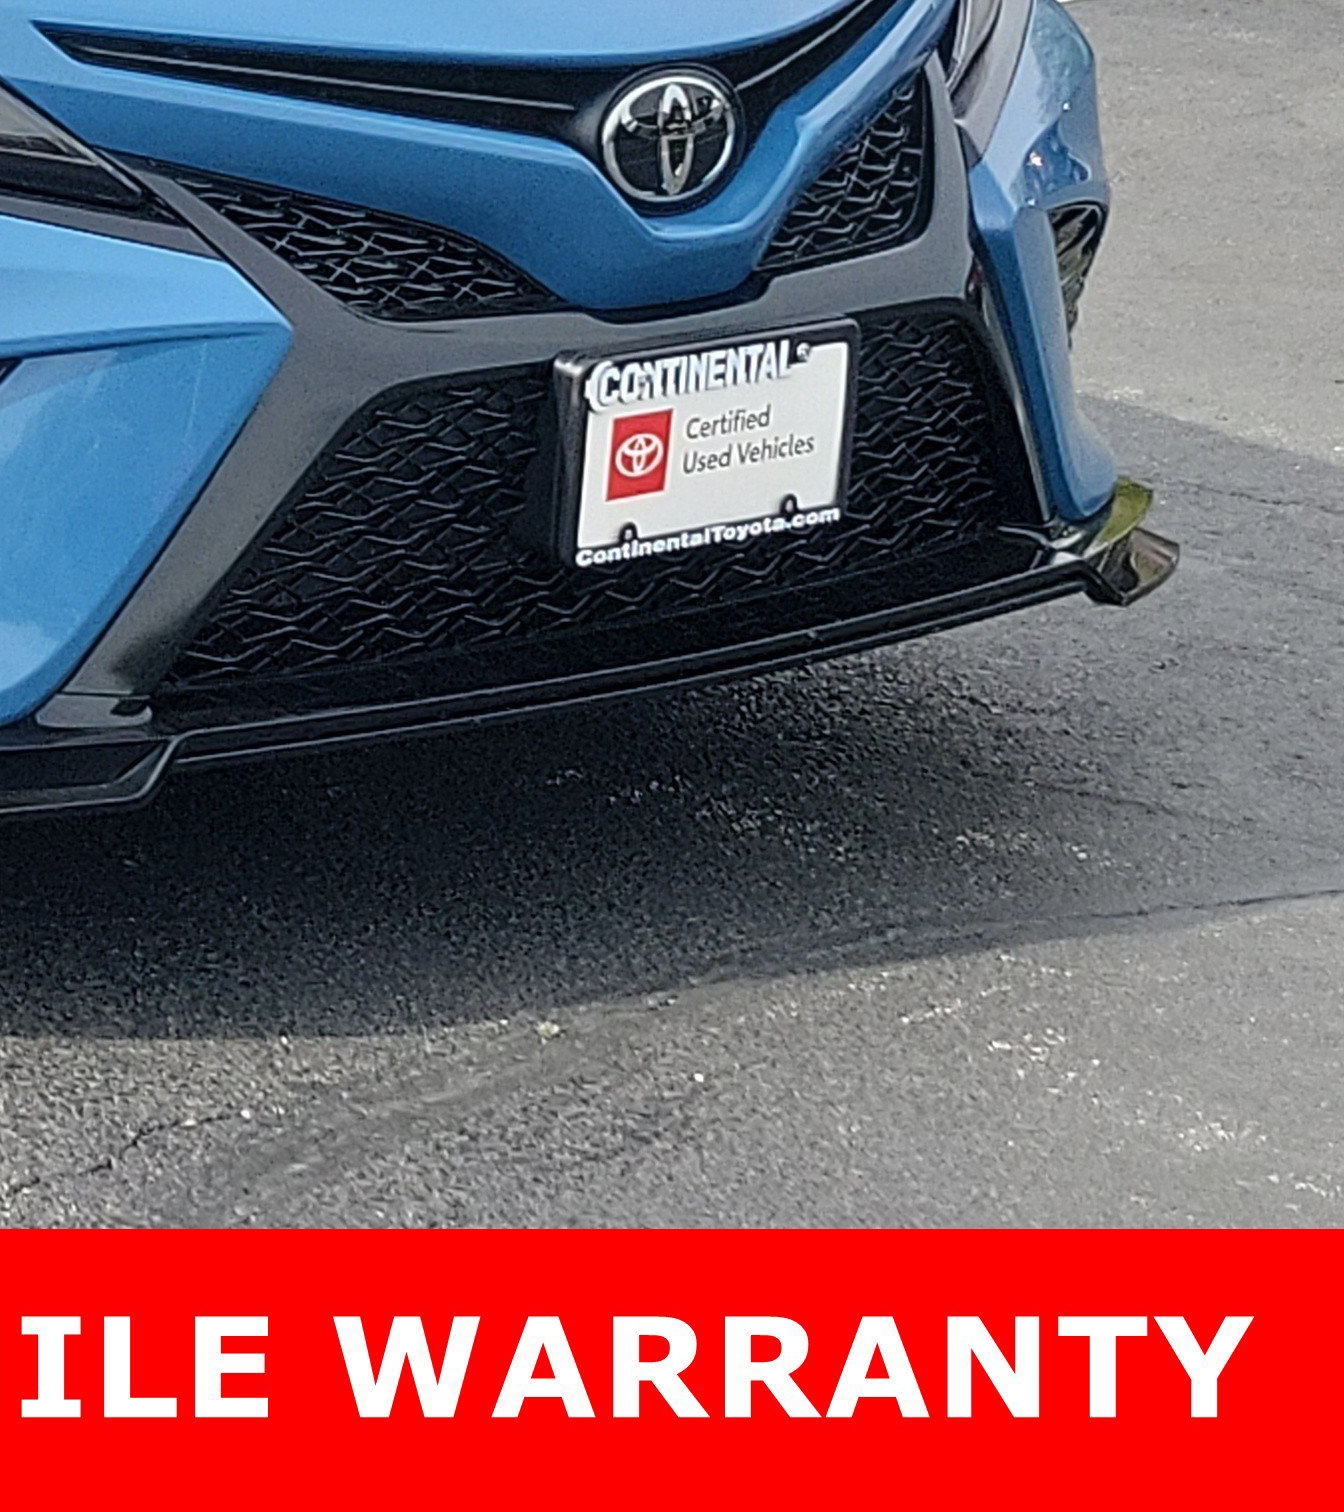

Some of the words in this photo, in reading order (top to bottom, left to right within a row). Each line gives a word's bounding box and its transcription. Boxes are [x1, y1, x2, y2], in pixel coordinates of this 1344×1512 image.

[598, 339, 793, 406] CONTINENTAL
[686, 403, 771, 439] Certified
[683, 443, 732, 474] Used
[737, 432, 815, 464] Vehicles
[575, 507, 842, 567] ContinentalToyota.com
